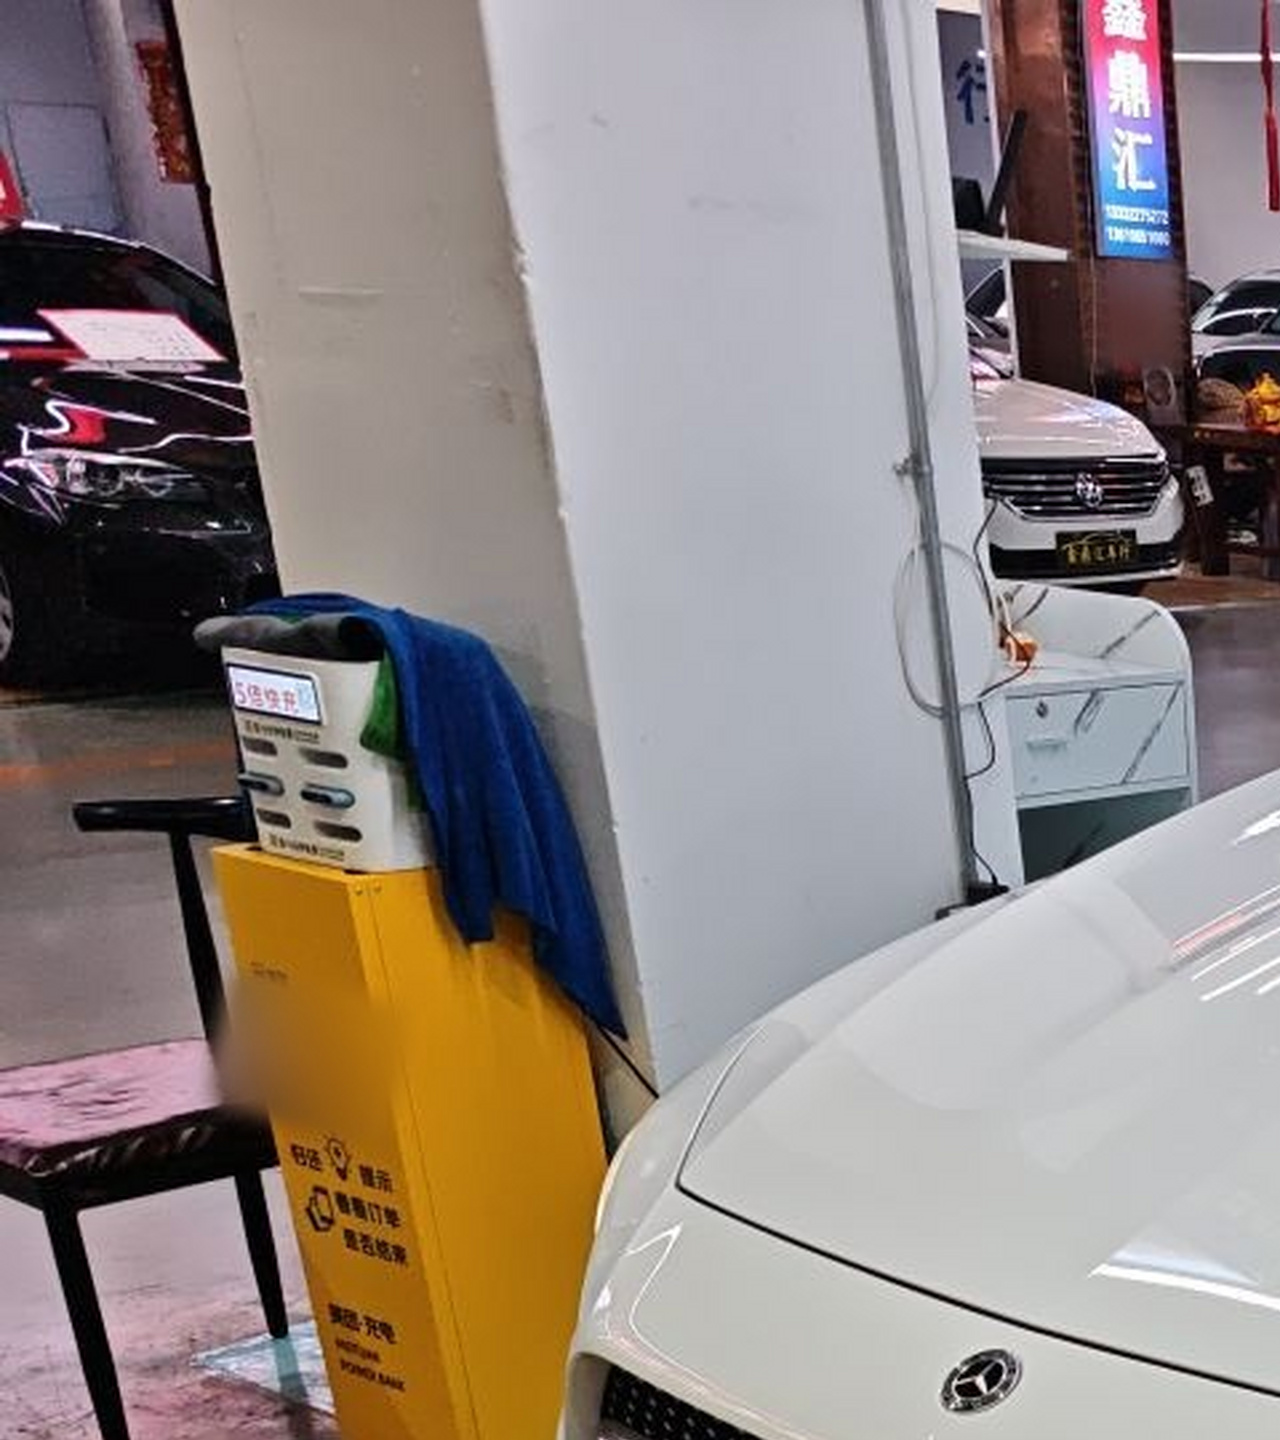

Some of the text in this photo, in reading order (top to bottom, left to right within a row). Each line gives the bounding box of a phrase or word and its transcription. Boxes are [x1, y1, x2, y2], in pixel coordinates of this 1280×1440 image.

[235, 681, 299, 713] 5倍快充
[358, 1163, 394, 1195] 提示
[343, 1227, 407, 1268] 是否结束
